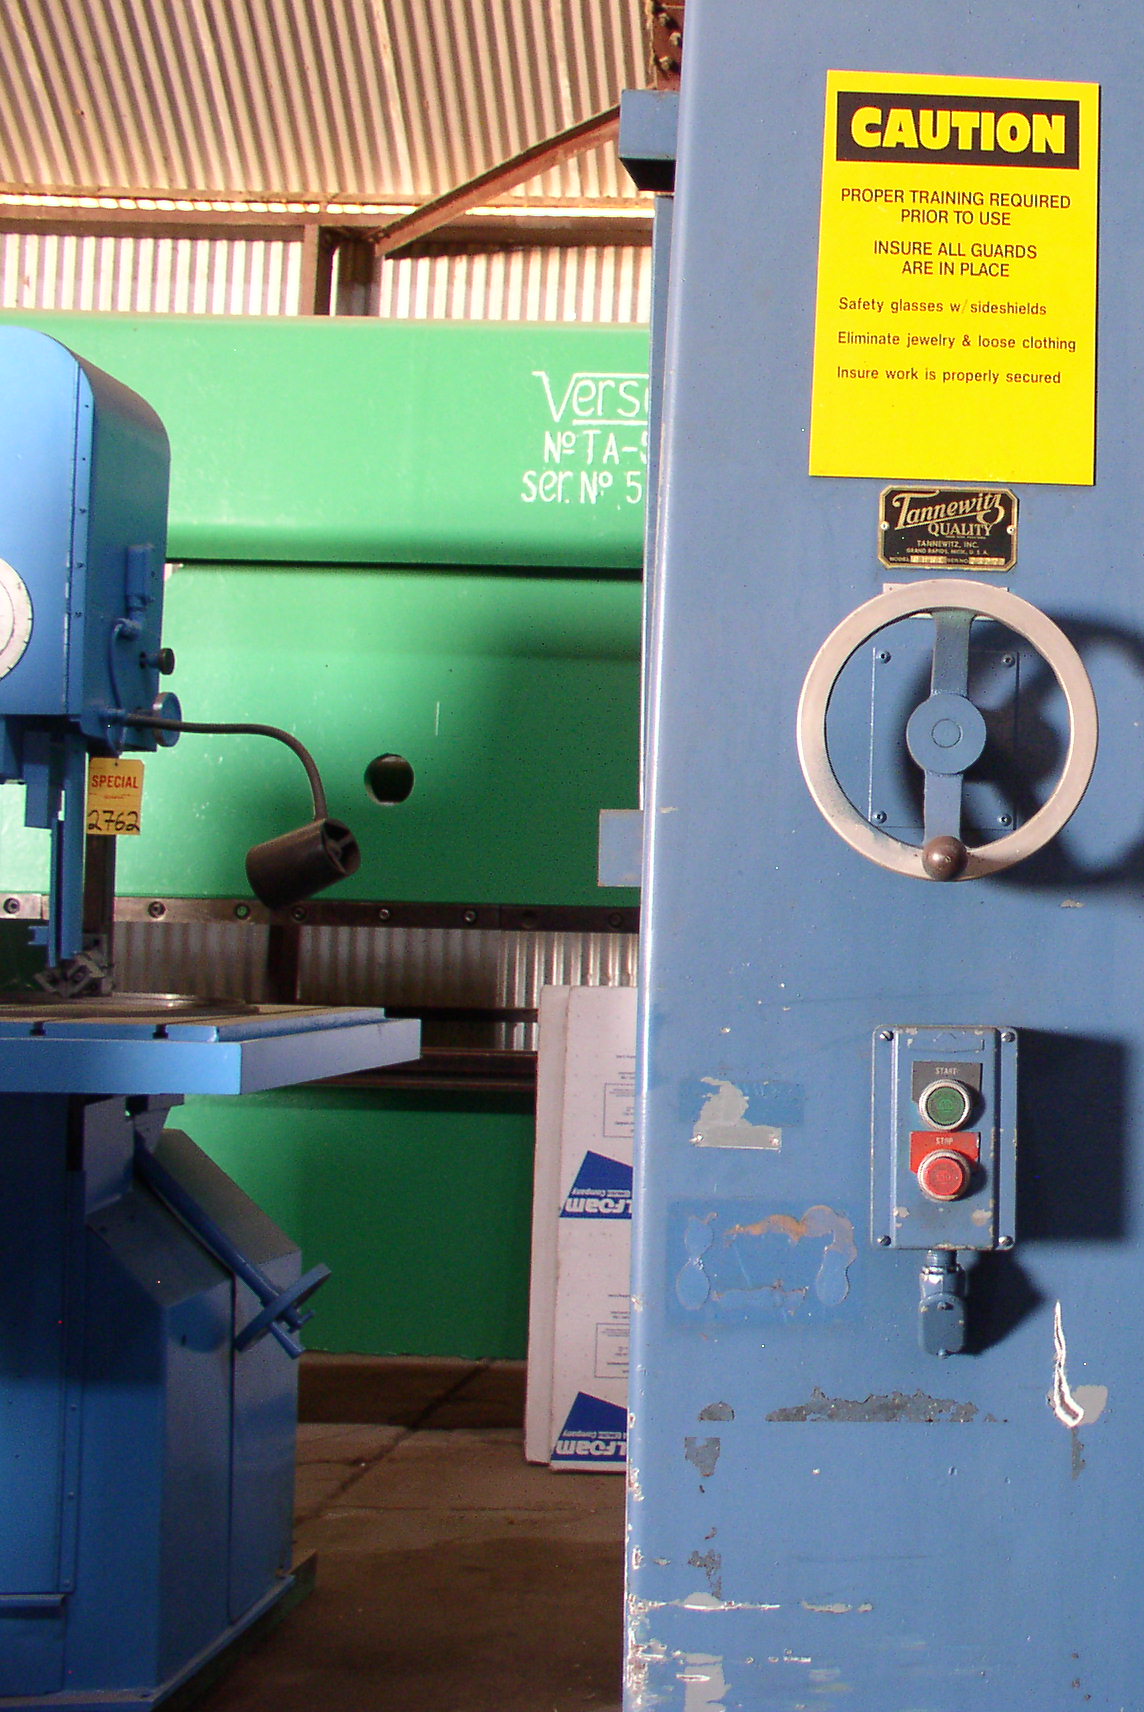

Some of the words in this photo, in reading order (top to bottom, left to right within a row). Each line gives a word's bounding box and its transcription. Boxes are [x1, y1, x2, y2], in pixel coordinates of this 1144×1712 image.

[851, 106, 1066, 154] CAUTION
[841, 188, 904, 203] PROPER
[909, 190, 985, 206] TRAINING
[990, 193, 1071, 209] REQUIRED
[901, 209, 948, 224] PRIOR
[954, 211, 974, 225] TO
[979, 212, 1011, 226] USE
[874, 240, 932, 256] INSURE
[938, 243, 965, 257] ALL
[971, 244, 1037, 259] GUARDS
[902, 261, 933, 275] ARE
[939, 262, 954, 276] IN
[960, 263, 1010, 277] PLACE
[839, 297, 884, 313] Safety
[891, 299, 944, 313] glasses
[838, 331, 900, 346] Eliminate
[906, 333, 956, 349] jewelry
[962, 335, 972, 347] &
[978, 335, 1016, 348] loose
[1022, 337, 1077, 353] clothing
[837, 366, 879, 380] Insure
[885, 367, 919, 380] work
[925, 368, 937, 380] is
[942, 369, 1000, 384] properly
[1005, 371, 1062, 384] secured
[892, 490, 1005, 530] Tannewitz
[928, 522, 993, 537] QUALITY
[964, 541, 980, 549] INC.
[91, 775, 139, 789] SPECIAL
[87, 809, 140, 832] 2762
[936, 1066, 957, 1075] START
[936, 1137, 954, 1146] STOP
